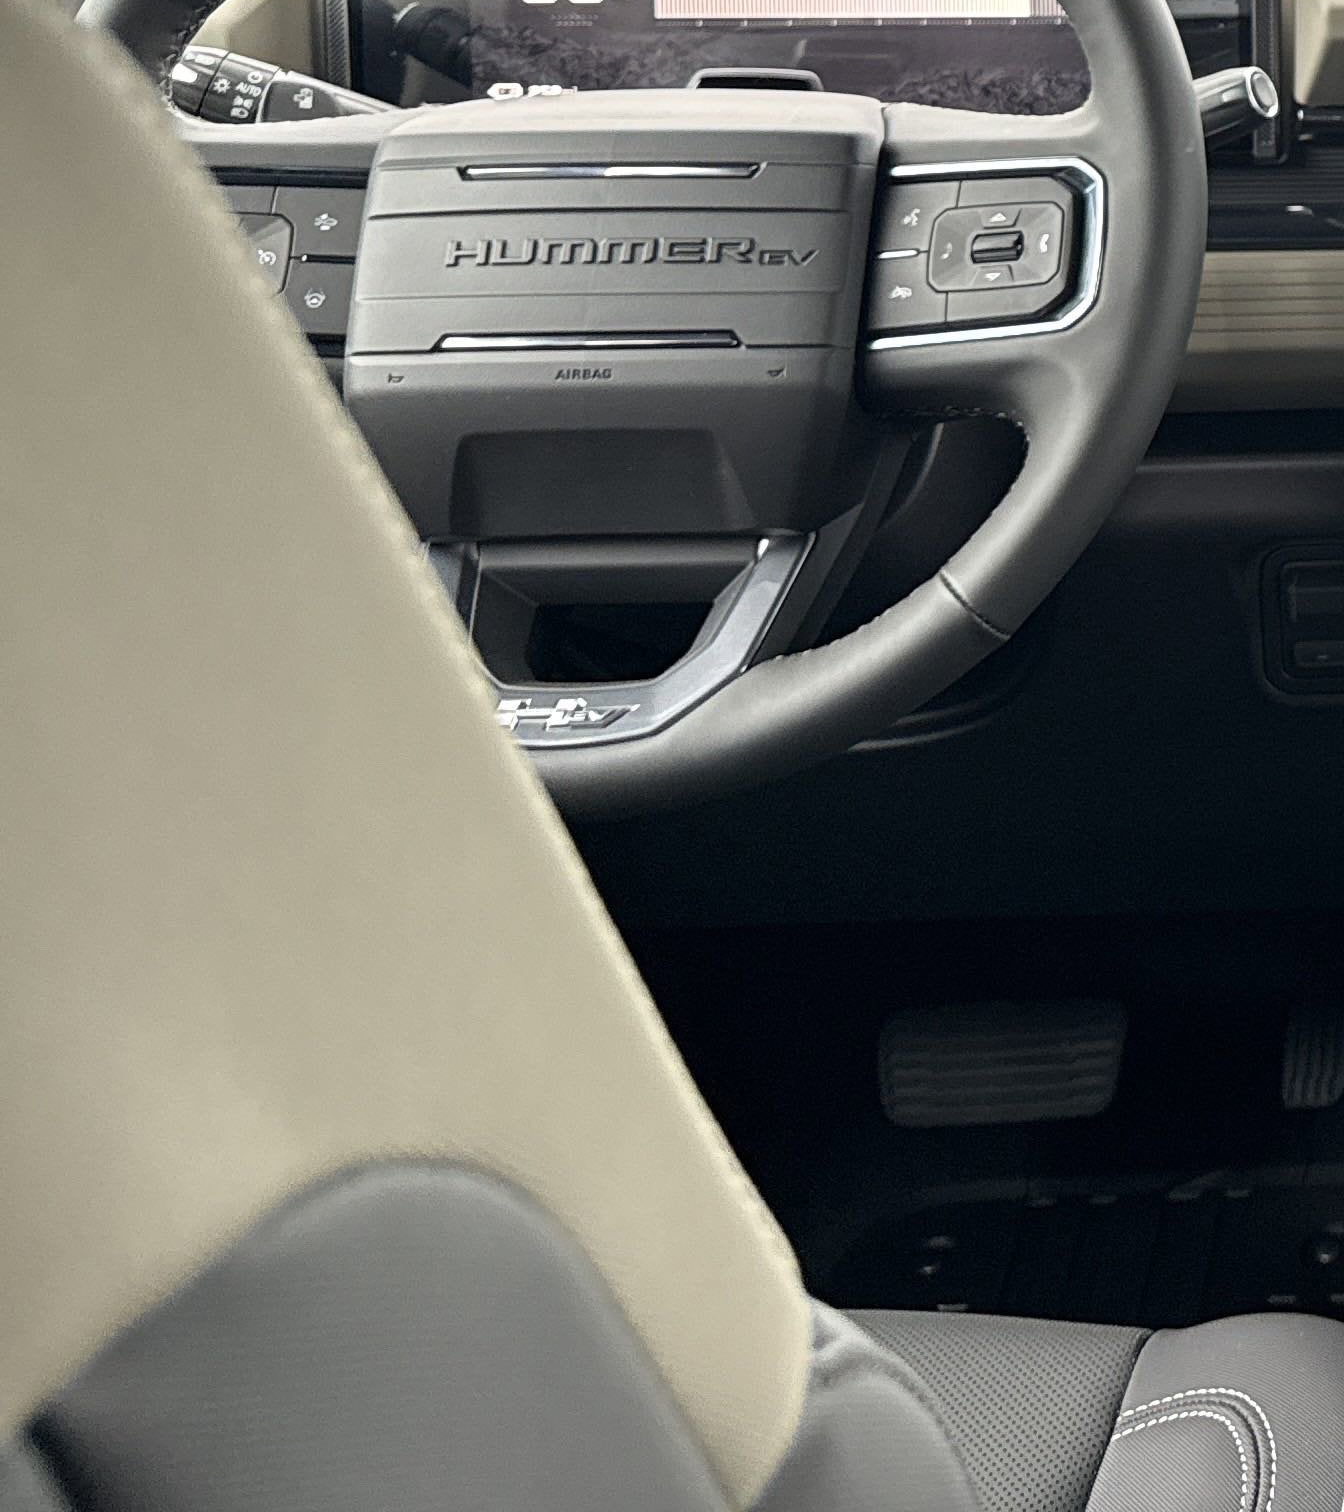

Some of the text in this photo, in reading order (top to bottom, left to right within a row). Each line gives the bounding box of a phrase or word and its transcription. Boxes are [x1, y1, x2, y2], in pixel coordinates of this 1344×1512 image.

[235, 81, 262, 98] AUTO
[445, 237, 821, 267] HUMMER EV
[554, 368, 613, 381] AIRBAG
